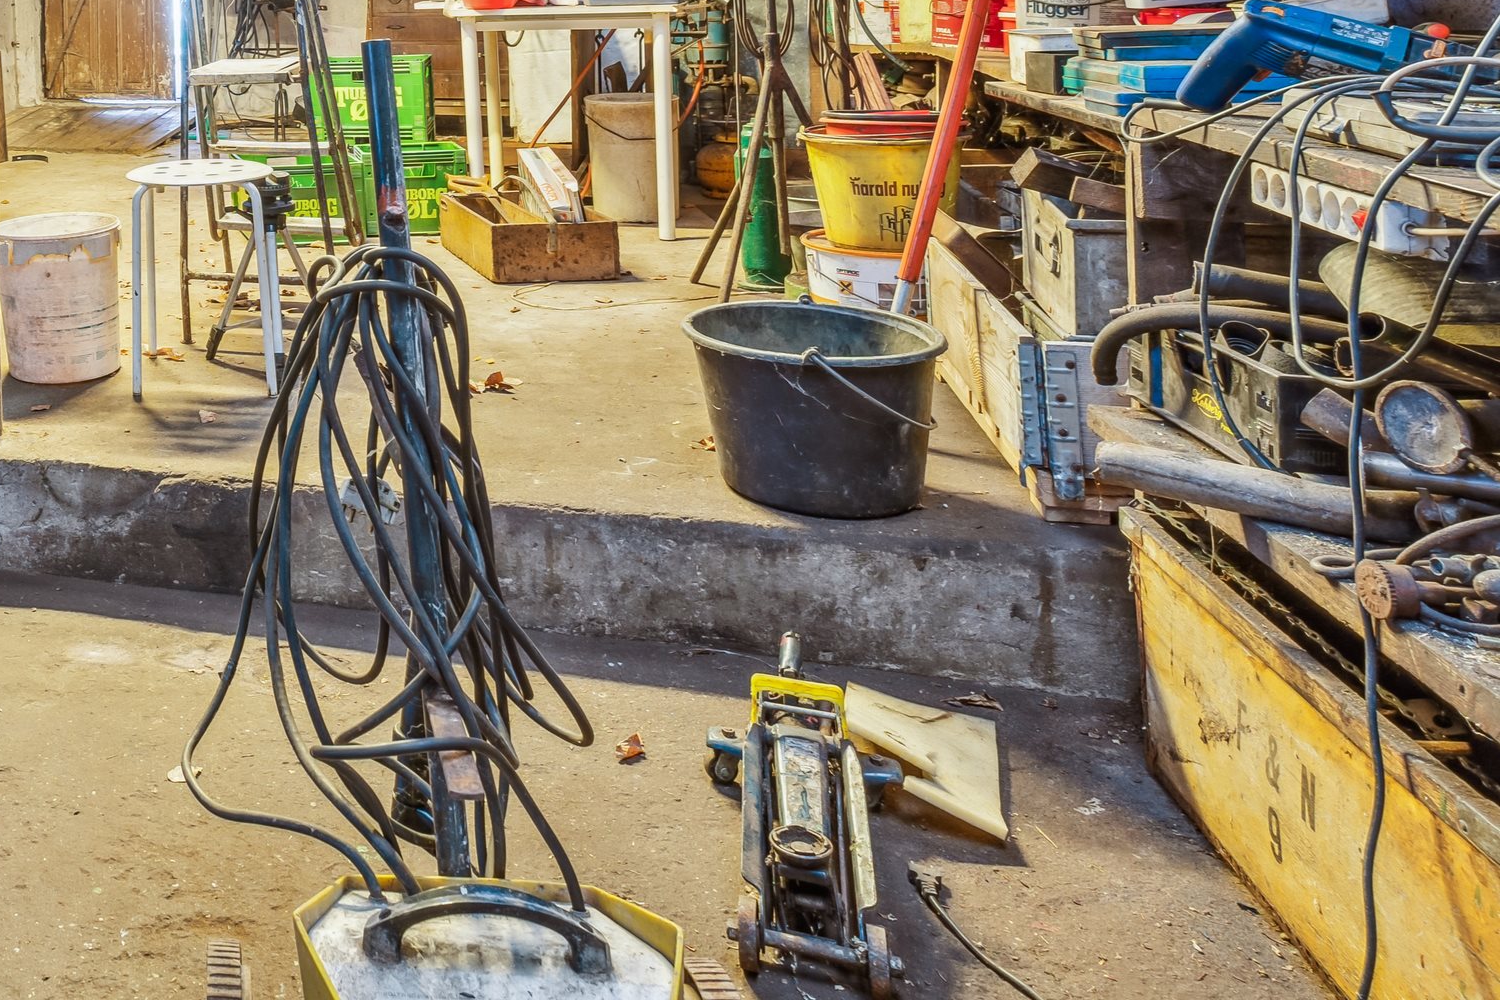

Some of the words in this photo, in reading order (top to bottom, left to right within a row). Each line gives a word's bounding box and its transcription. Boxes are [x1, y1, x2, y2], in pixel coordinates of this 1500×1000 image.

[850, 178, 898, 197] harald
[1301, 764, 1316, 832] N
[1268, 806, 1283, 864] 9
